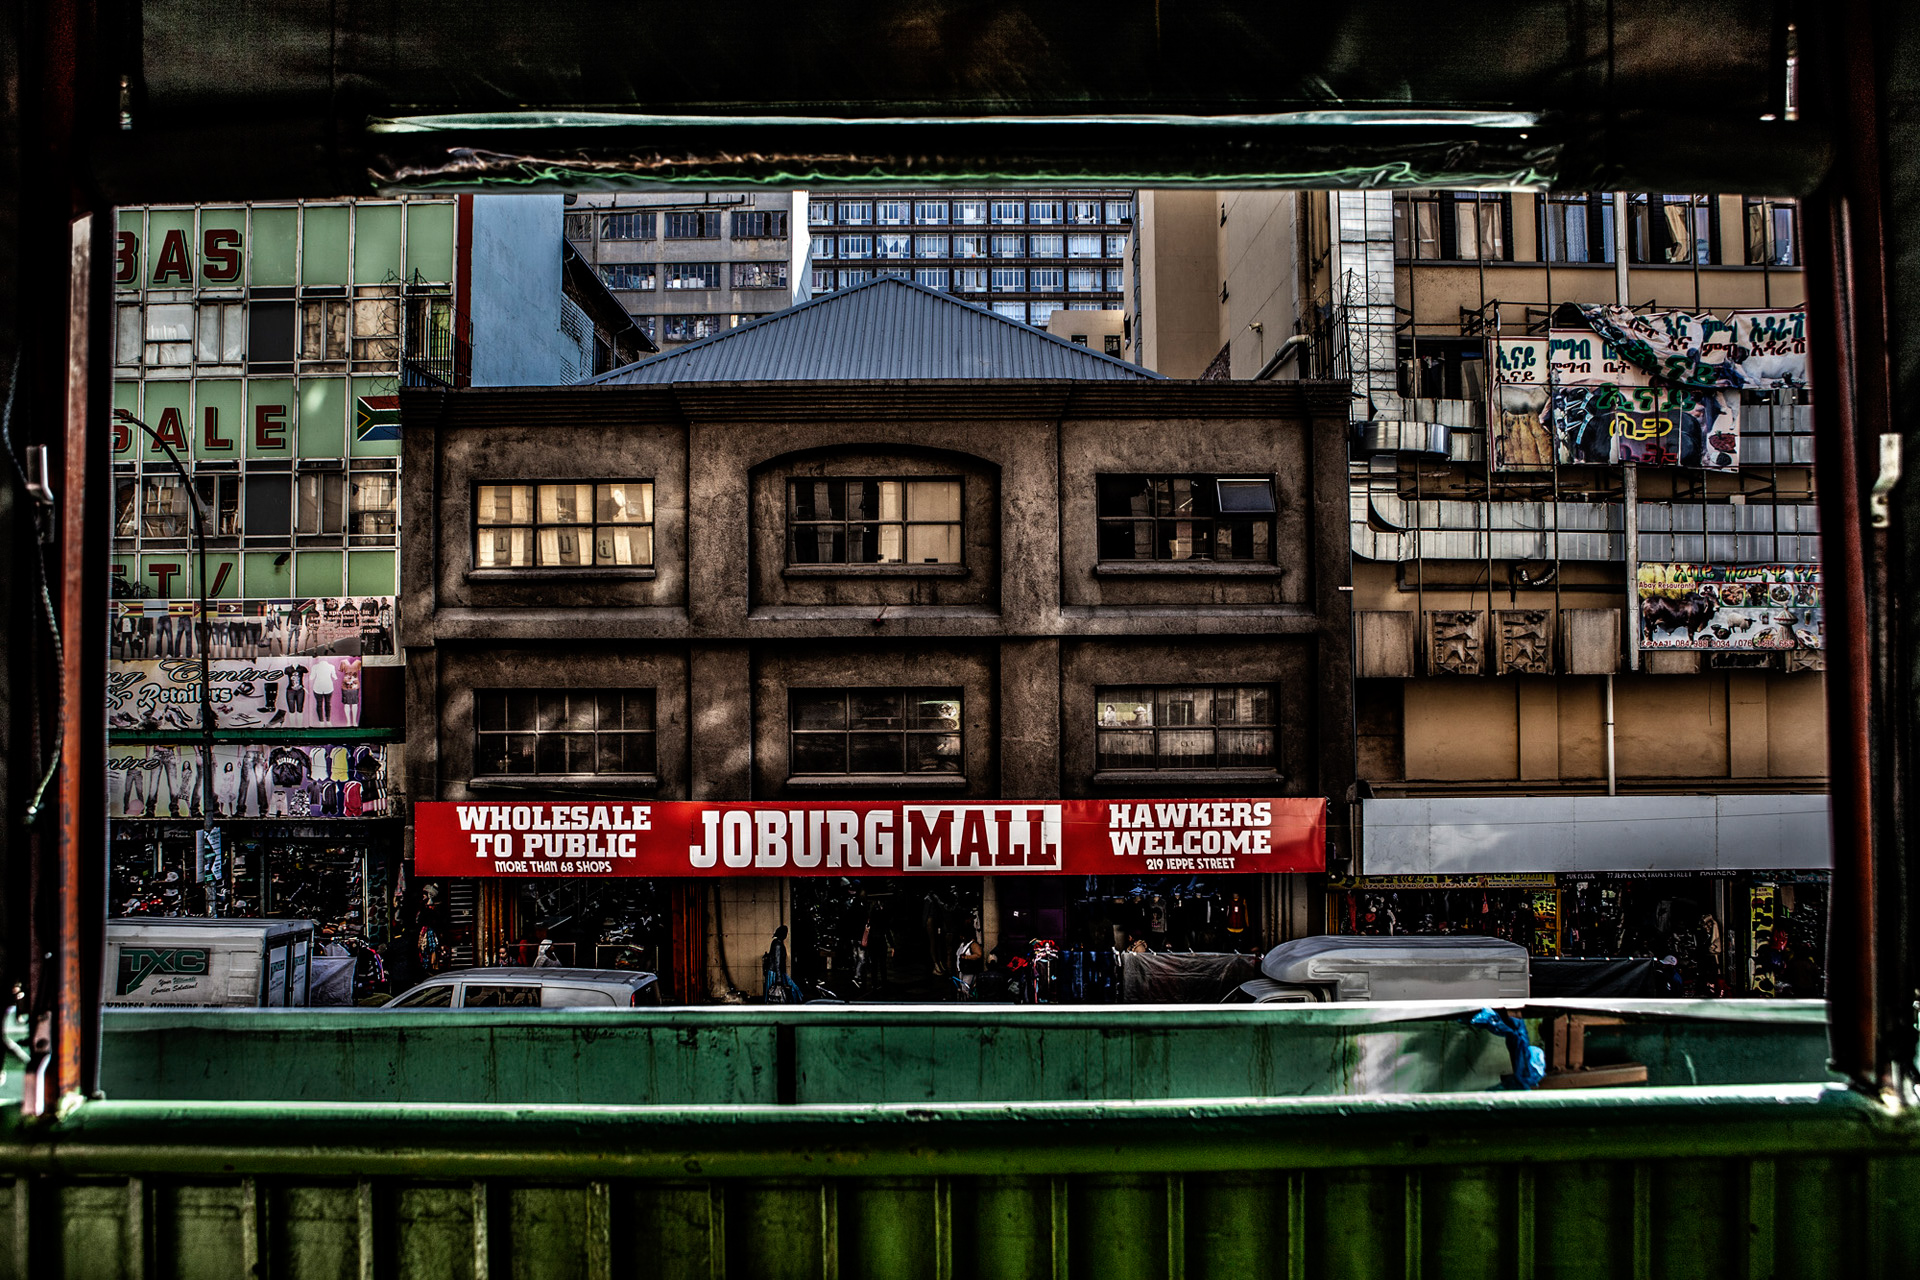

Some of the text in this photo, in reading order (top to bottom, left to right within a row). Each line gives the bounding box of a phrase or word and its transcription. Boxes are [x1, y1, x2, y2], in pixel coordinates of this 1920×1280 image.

[1639, 582, 1656, 590] Abay
[137, 683, 233, 709] Retailrs
[456, 805, 651, 831] WHOLESALE
[1109, 802, 1272, 828] HAWKERS
[470, 832, 637, 858] TO PUBLIC
[689, 809, 1057, 867] JOBURG MALL
[1109, 829, 1272, 856] WELCOME
[495, 860, 612, 873] MORE THAN 68 SHOPS
[1146, 857, 1236, 870] 219 JEPPE STREET
[121, 949, 206, 973] TXC
[151, 987, 171, 995] Courier
[158, 979, 172, 987] Your
